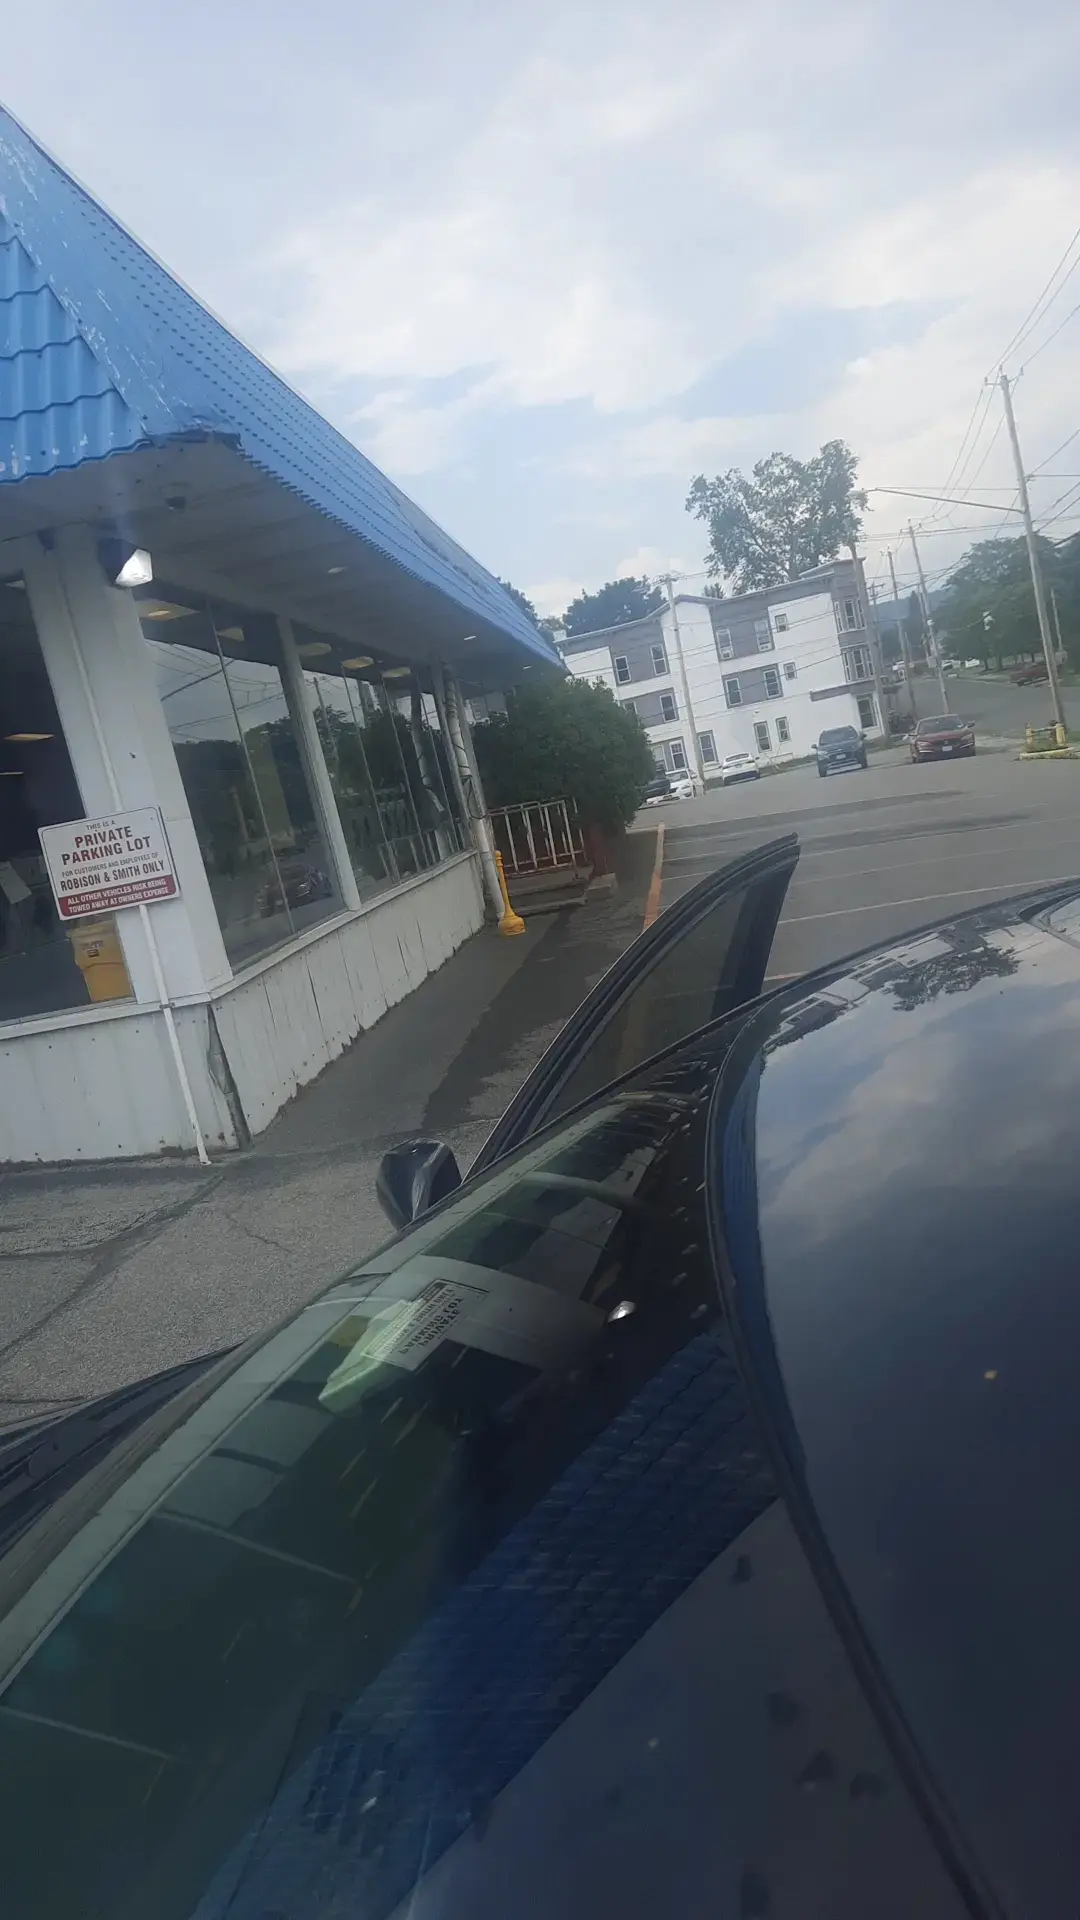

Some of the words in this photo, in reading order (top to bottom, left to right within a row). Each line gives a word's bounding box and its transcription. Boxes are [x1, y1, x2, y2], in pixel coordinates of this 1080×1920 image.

[75, 826, 133, 848] PRIVATE
[86, 822, 100, 830] THIS
[61, 842, 123, 865] PARKING
[126, 836, 151, 852] LOT
[60, 873, 101, 892] ROBISON
[103, 872, 111, 883] &
[112, 865, 141, 880] SMITH
[142, 860, 165, 874] ONLY
[62, 870, 74, 878] FOR
[74, 863, 108, 875] CUSTOMERS
[108, 860, 119, 868] AND
[120, 854, 151, 866] EMPLOYEES
[68, 903, 91, 914] TOWED
[91, 899, 110, 909] AWAY
[118, 891, 143, 904] OWNERS
[143, 886, 169, 898] EXPENSE
[80, 891, 102, 903] OTHER
[103, 886, 131, 897] VEHICLES
[133, 882, 147, 891] RISK
[147, 879, 167, 888] BEING
